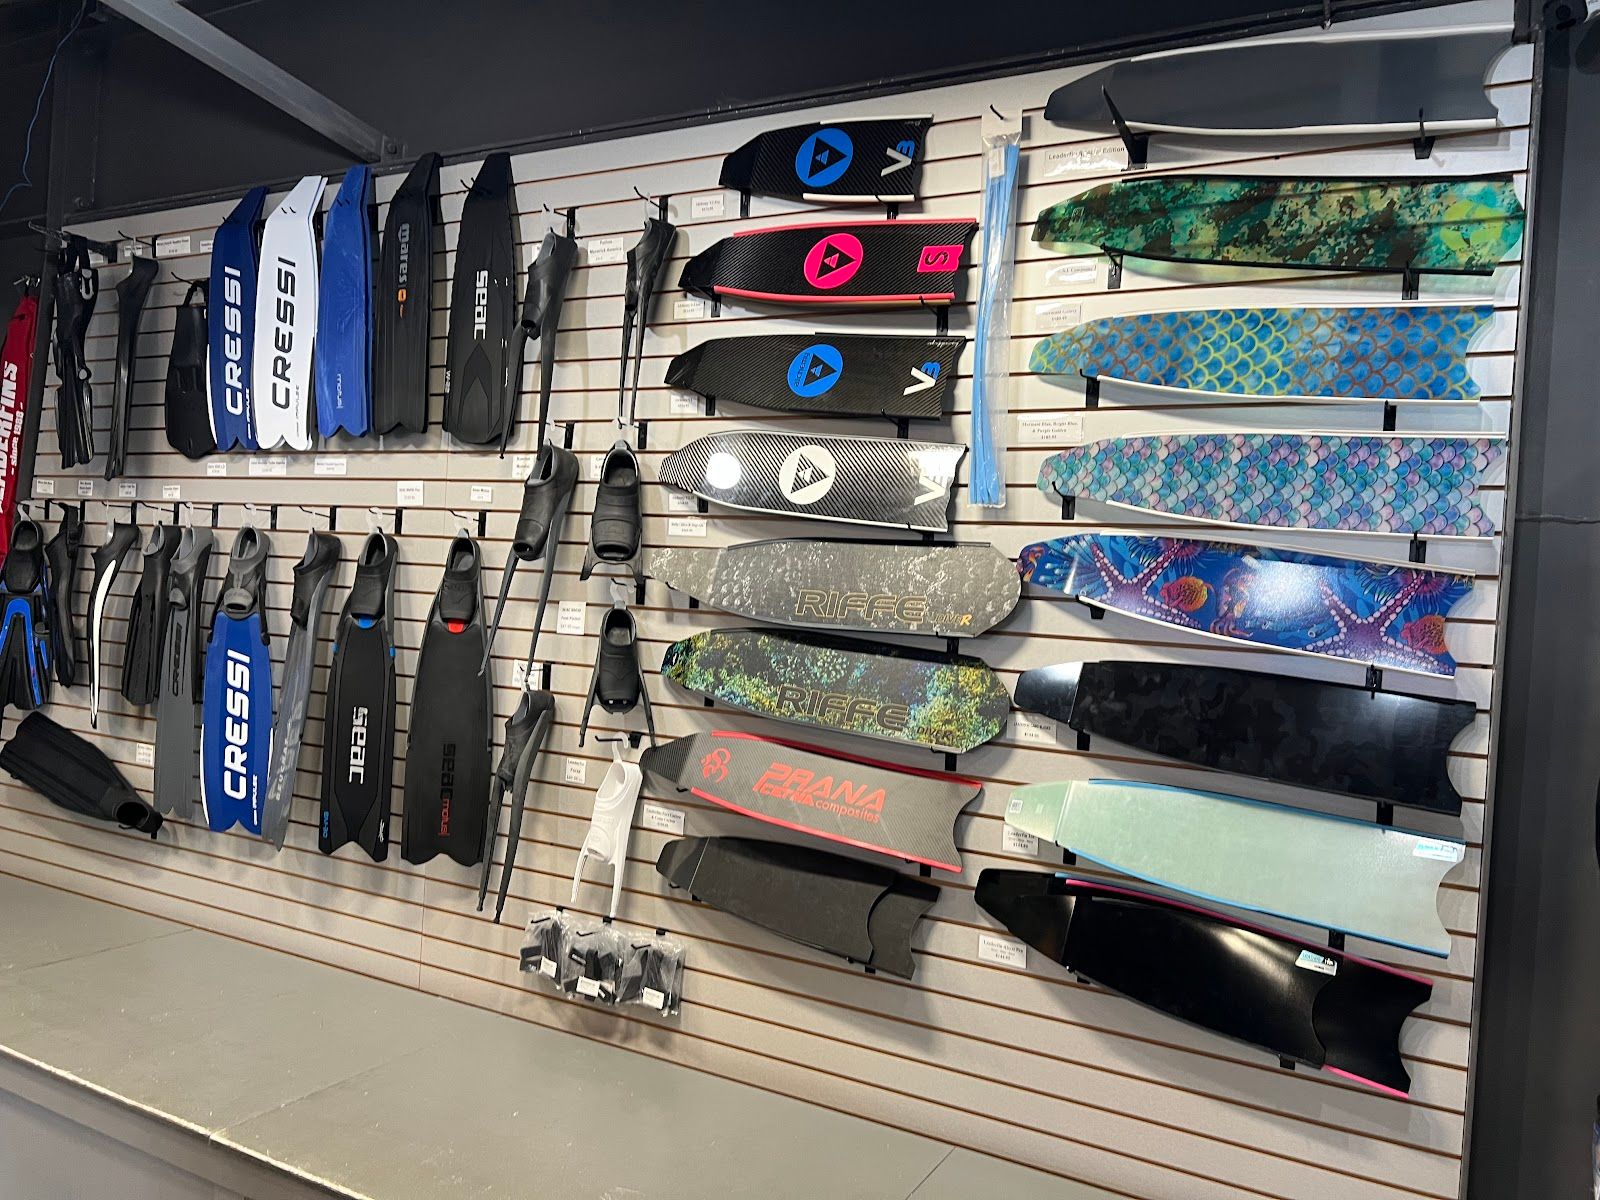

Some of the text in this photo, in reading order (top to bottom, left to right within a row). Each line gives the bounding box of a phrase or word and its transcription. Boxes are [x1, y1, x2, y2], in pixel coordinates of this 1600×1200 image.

[881, 138, 916, 177] V3
[398, 222, 411, 285] mares
[473, 269, 489, 340] seac
[224, 265, 243, 416] CRESSI
[272, 256, 296, 410] CRESSI
[902, 361, 941, 396] V3
[794, 588, 928, 625] RIFFE
[223, 649, 250, 801] CRESSI
[774, 682, 910, 733] RIFFE
[348, 705, 369, 785] seac
[752, 761, 887, 812] PRANA
[815, 798, 881, 824] composites
[439, 798, 450, 837] motus
